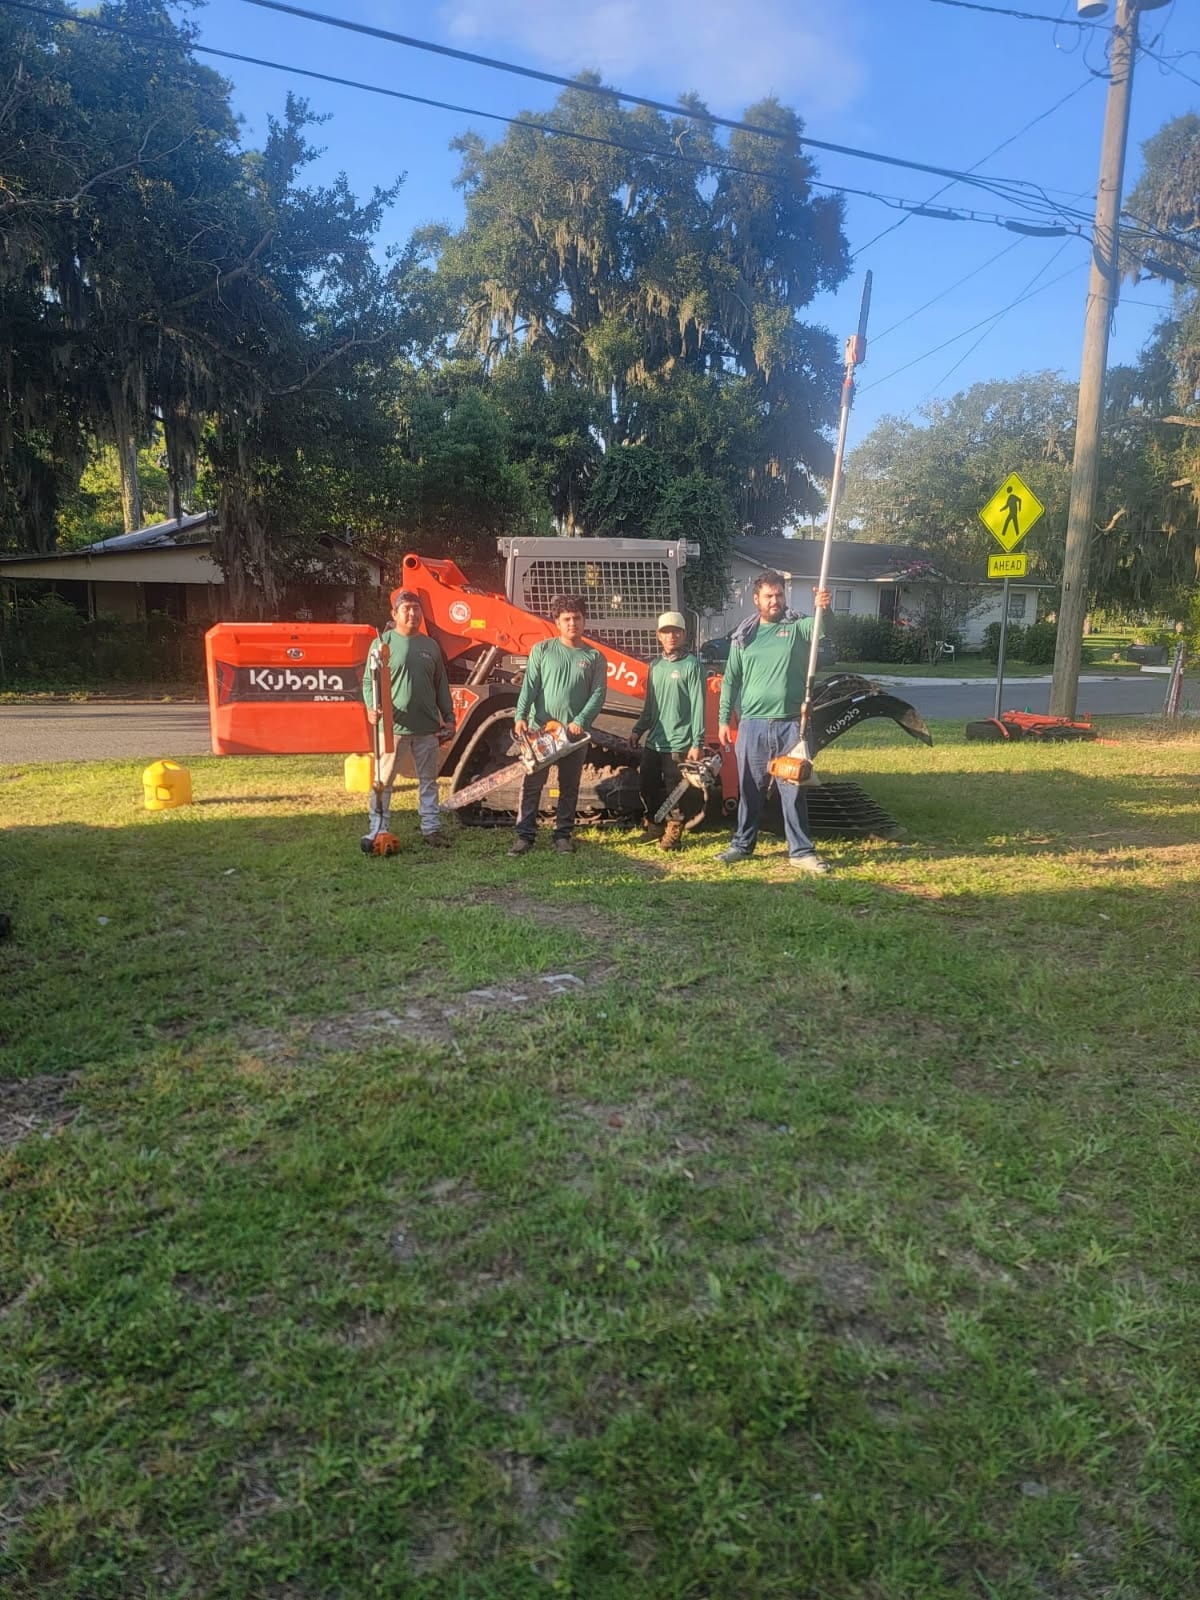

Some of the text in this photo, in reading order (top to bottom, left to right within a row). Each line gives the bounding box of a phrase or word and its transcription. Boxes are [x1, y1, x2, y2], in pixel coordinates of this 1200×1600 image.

[993, 559, 1022, 572] AHEAD
[249, 669, 344, 691] Kubota
[825, 708, 860, 735] Kubota
